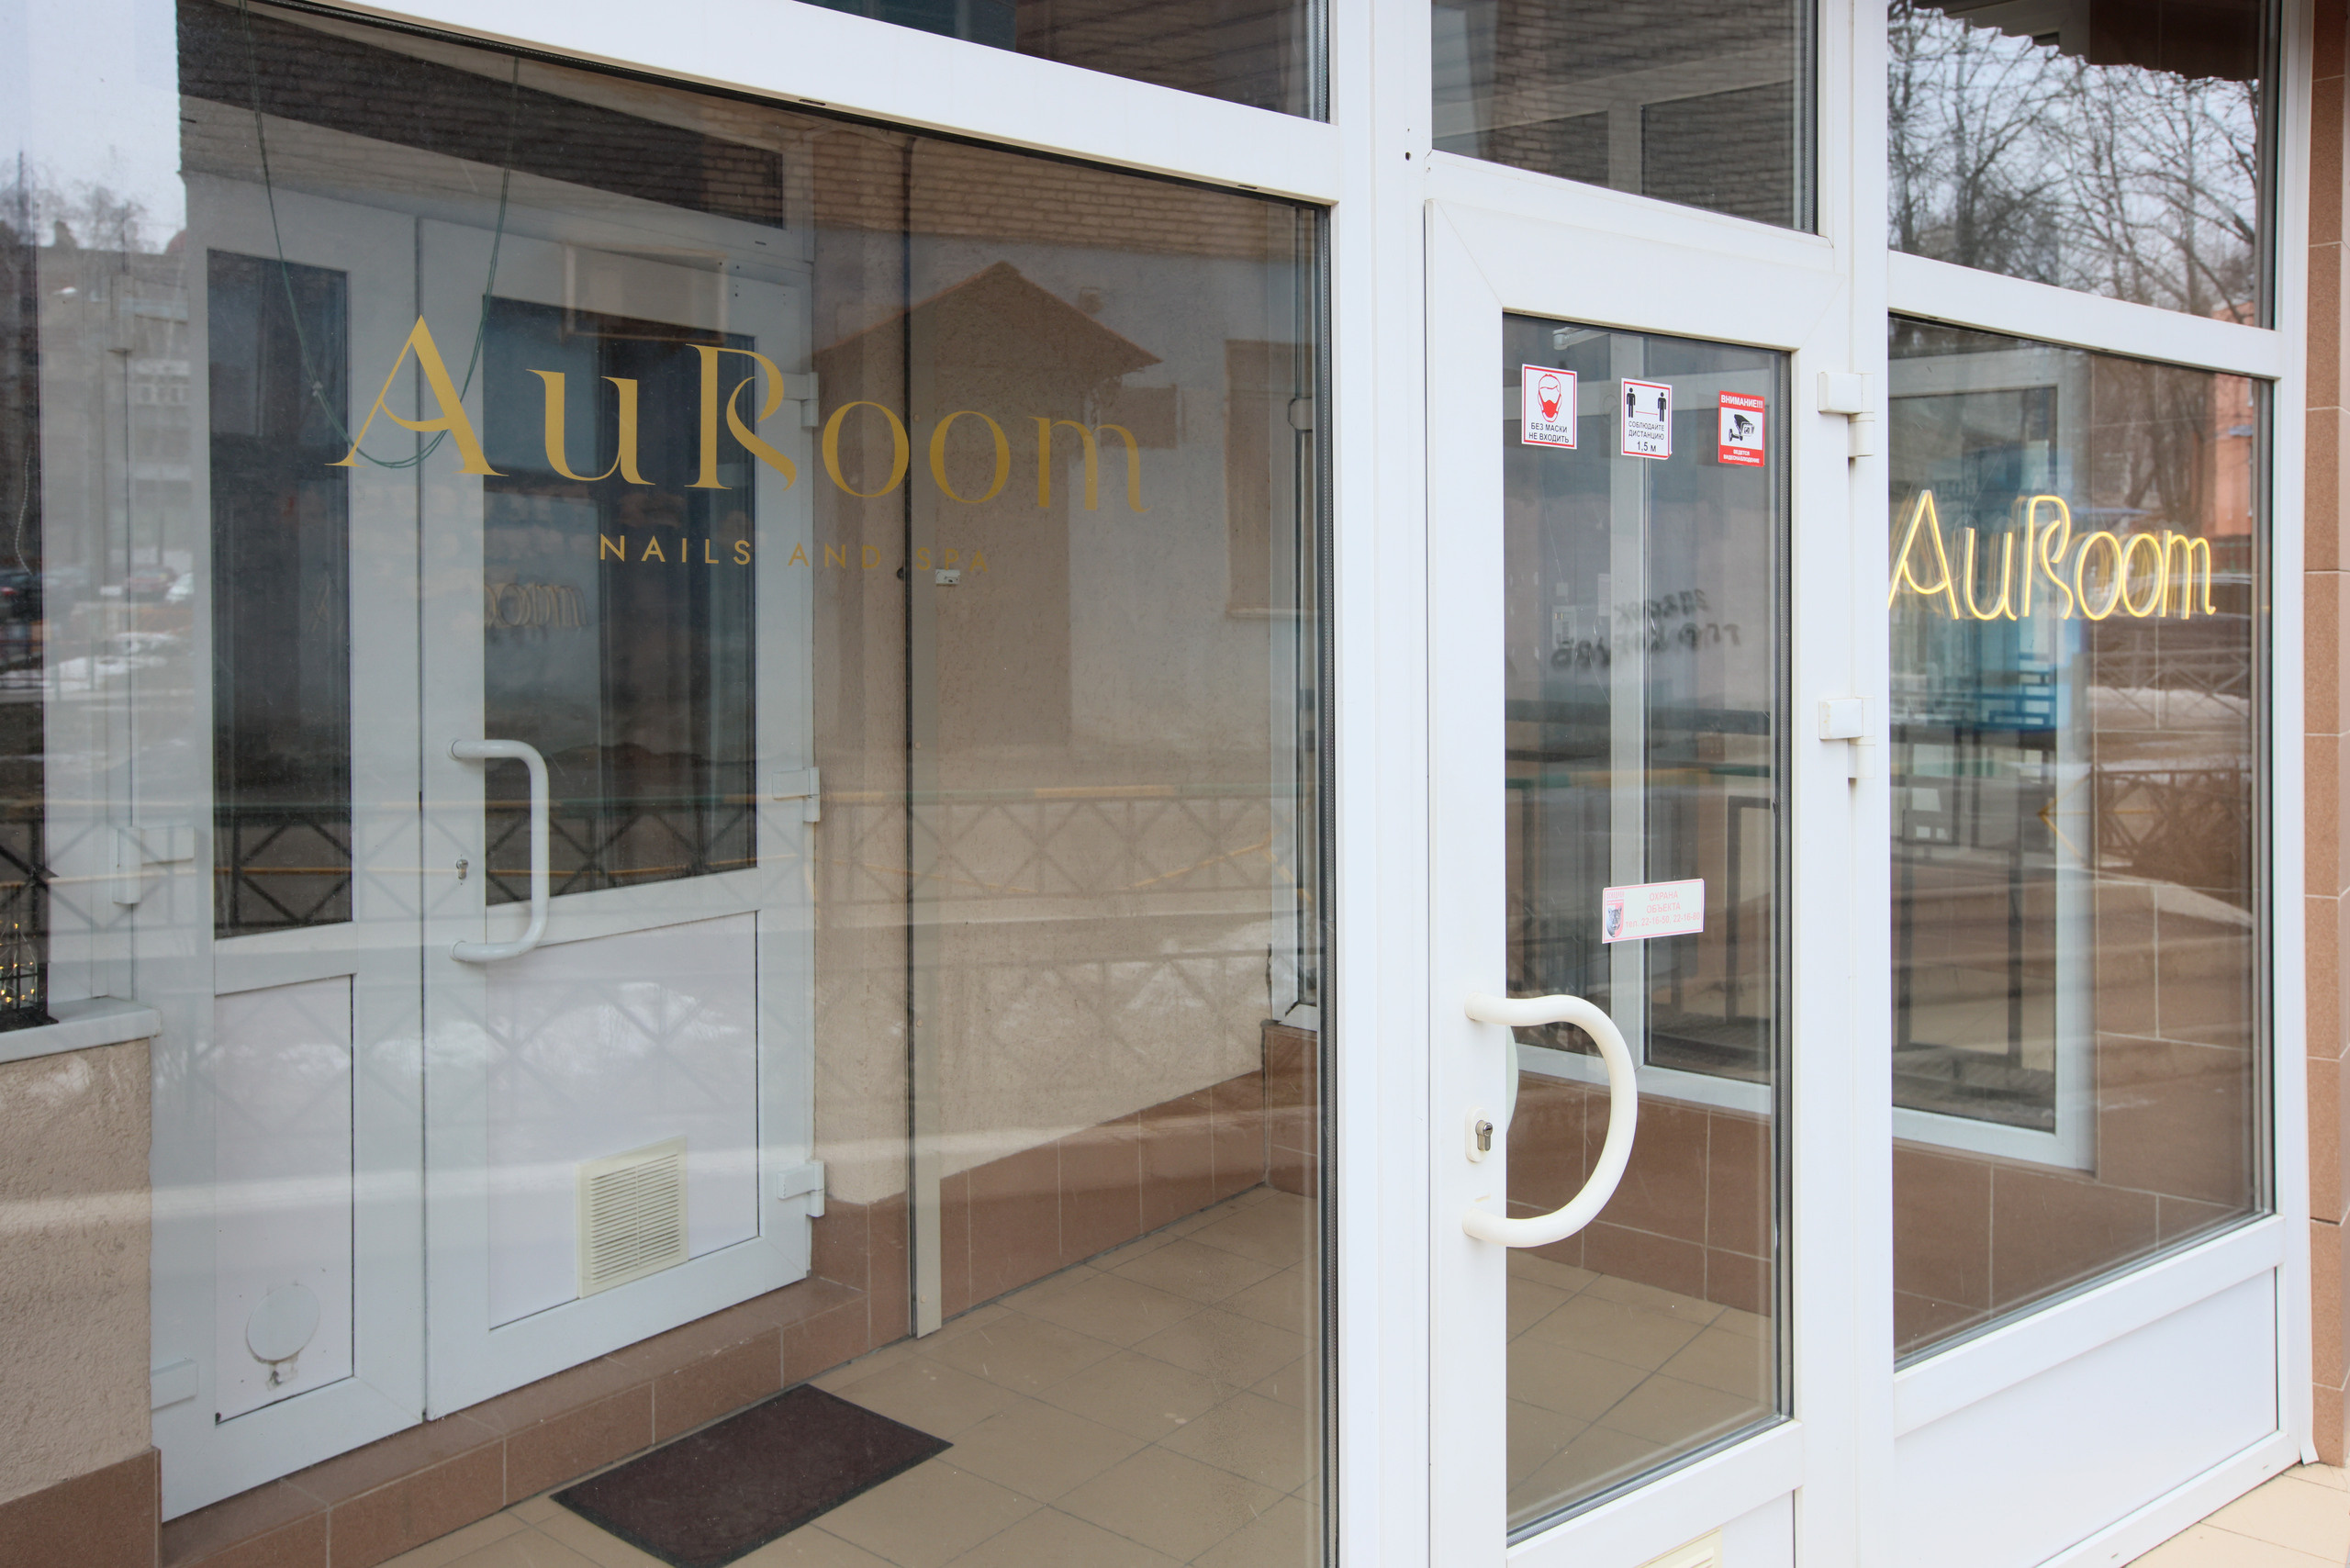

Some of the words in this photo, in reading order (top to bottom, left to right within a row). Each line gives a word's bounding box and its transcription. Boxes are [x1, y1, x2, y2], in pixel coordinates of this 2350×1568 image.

[1720, 395, 1763, 409] ВНИМАНИЕ!!!
[324, 314, 1149, 512] AuRoom
[1530, 422, 1543, 431] БЕЗ
[1545, 424, 1568, 432] МАСКИ
[1628, 420, 1664, 431] СОБЛЮДАЙТЕ
[1528, 431, 1538, 440] НЕ
[1539, 433, 1569, 443] ВХОДИТЬ
[1628, 431, 1664, 441] ДИСТАНЦИЮ
[1637, 442, 1649, 453] 1,5
[599, 533, 751, 566] NAILS
[788, 542, 881, 568] AND
[916, 547, 989, 572] SPA
[1888, 489, 2216, 621] AuRoom
[1649, 890, 1678, 902] ОХРАНА
[1646, 902, 1681, 913] ОБЪЕКТА
